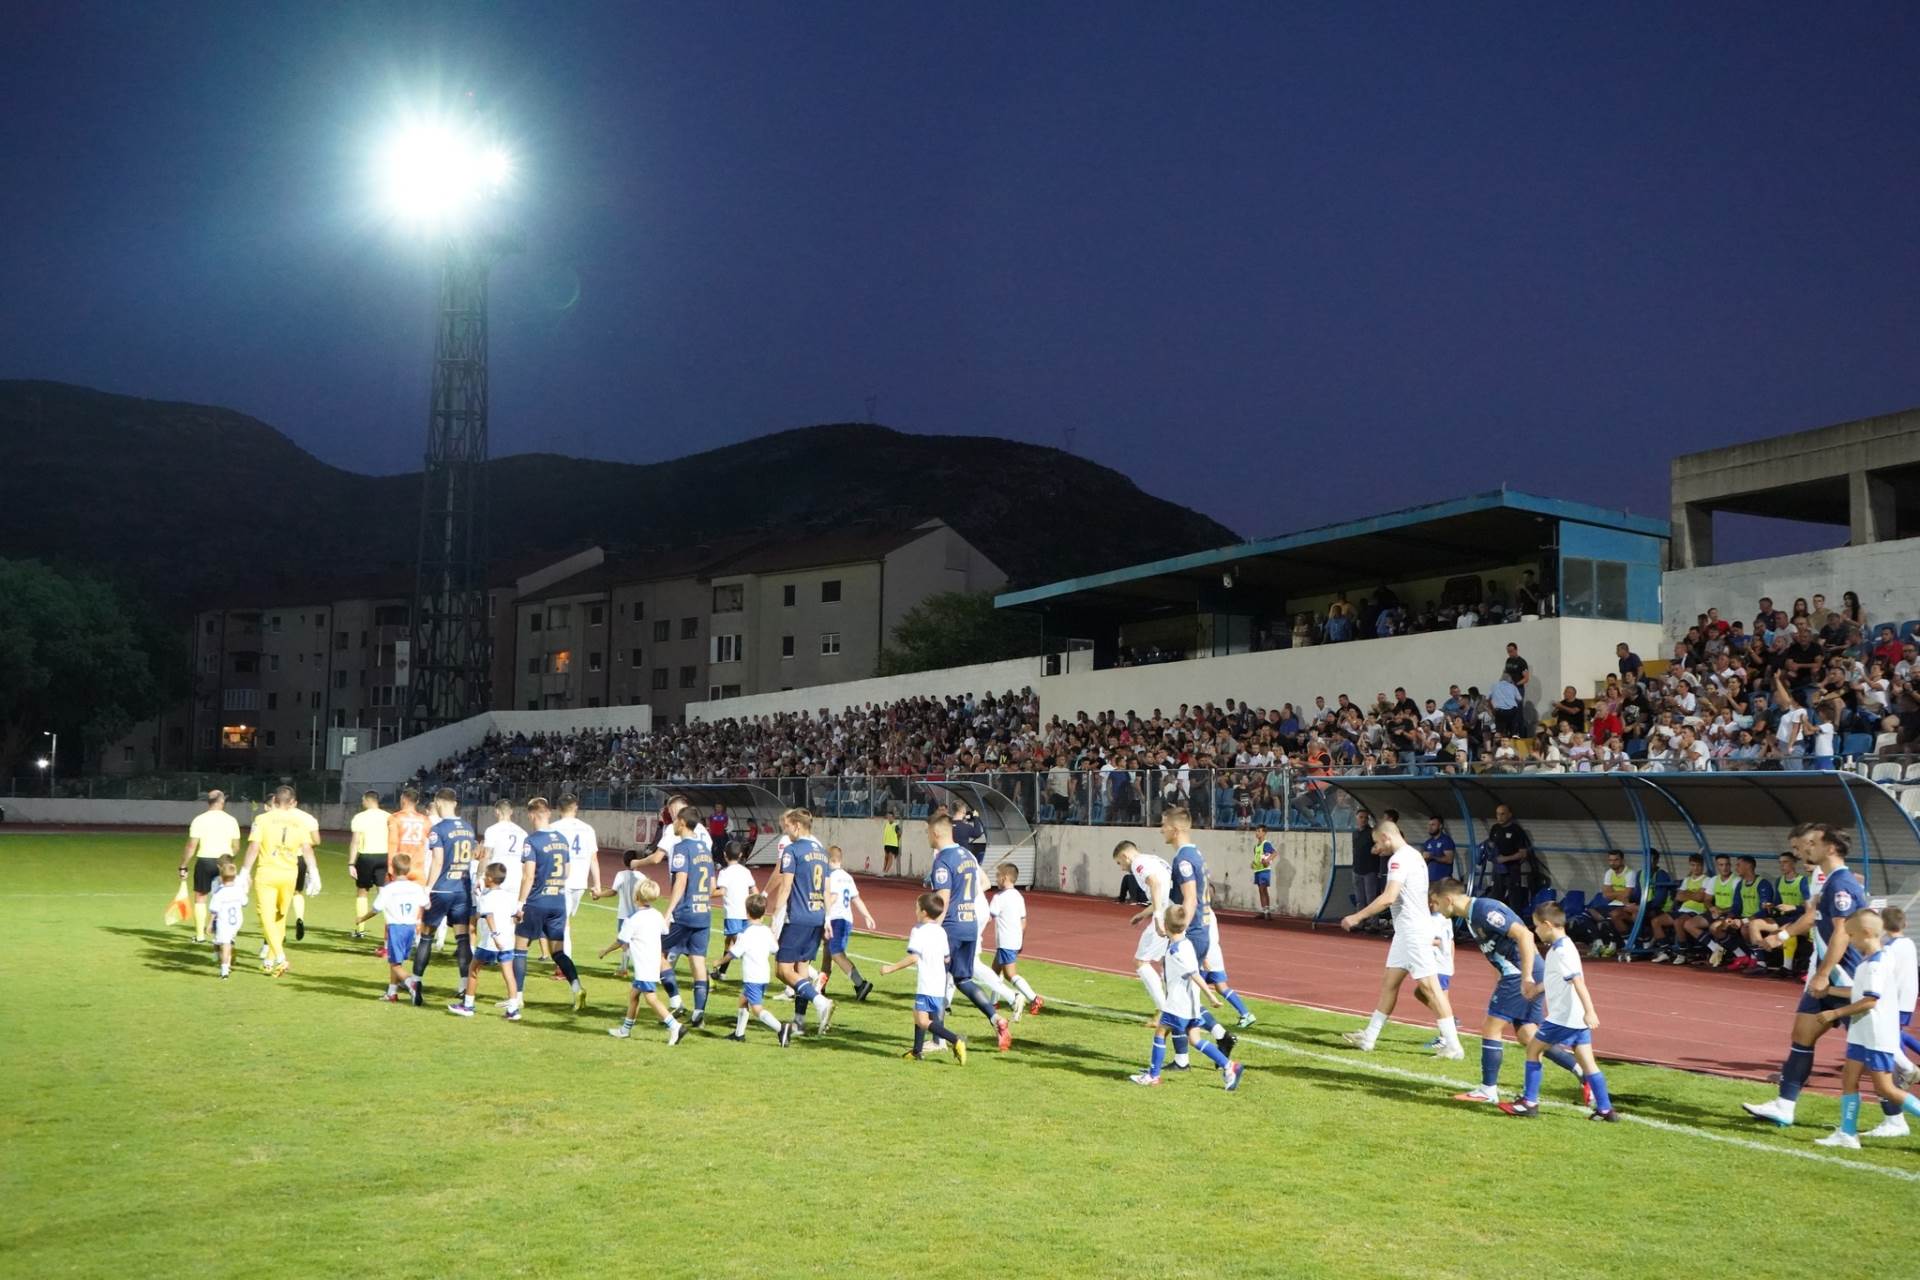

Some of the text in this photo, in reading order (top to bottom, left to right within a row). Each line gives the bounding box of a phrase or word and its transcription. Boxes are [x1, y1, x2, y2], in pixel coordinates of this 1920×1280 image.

[400, 819, 423, 843] 23
[453, 840, 471, 863] 18
[508, 834, 517, 853] 2
[571, 833, 581, 855] 4
[551, 853, 563, 877] 3
[698, 866, 708, 892] 2
[227, 906, 238, 926] 8
